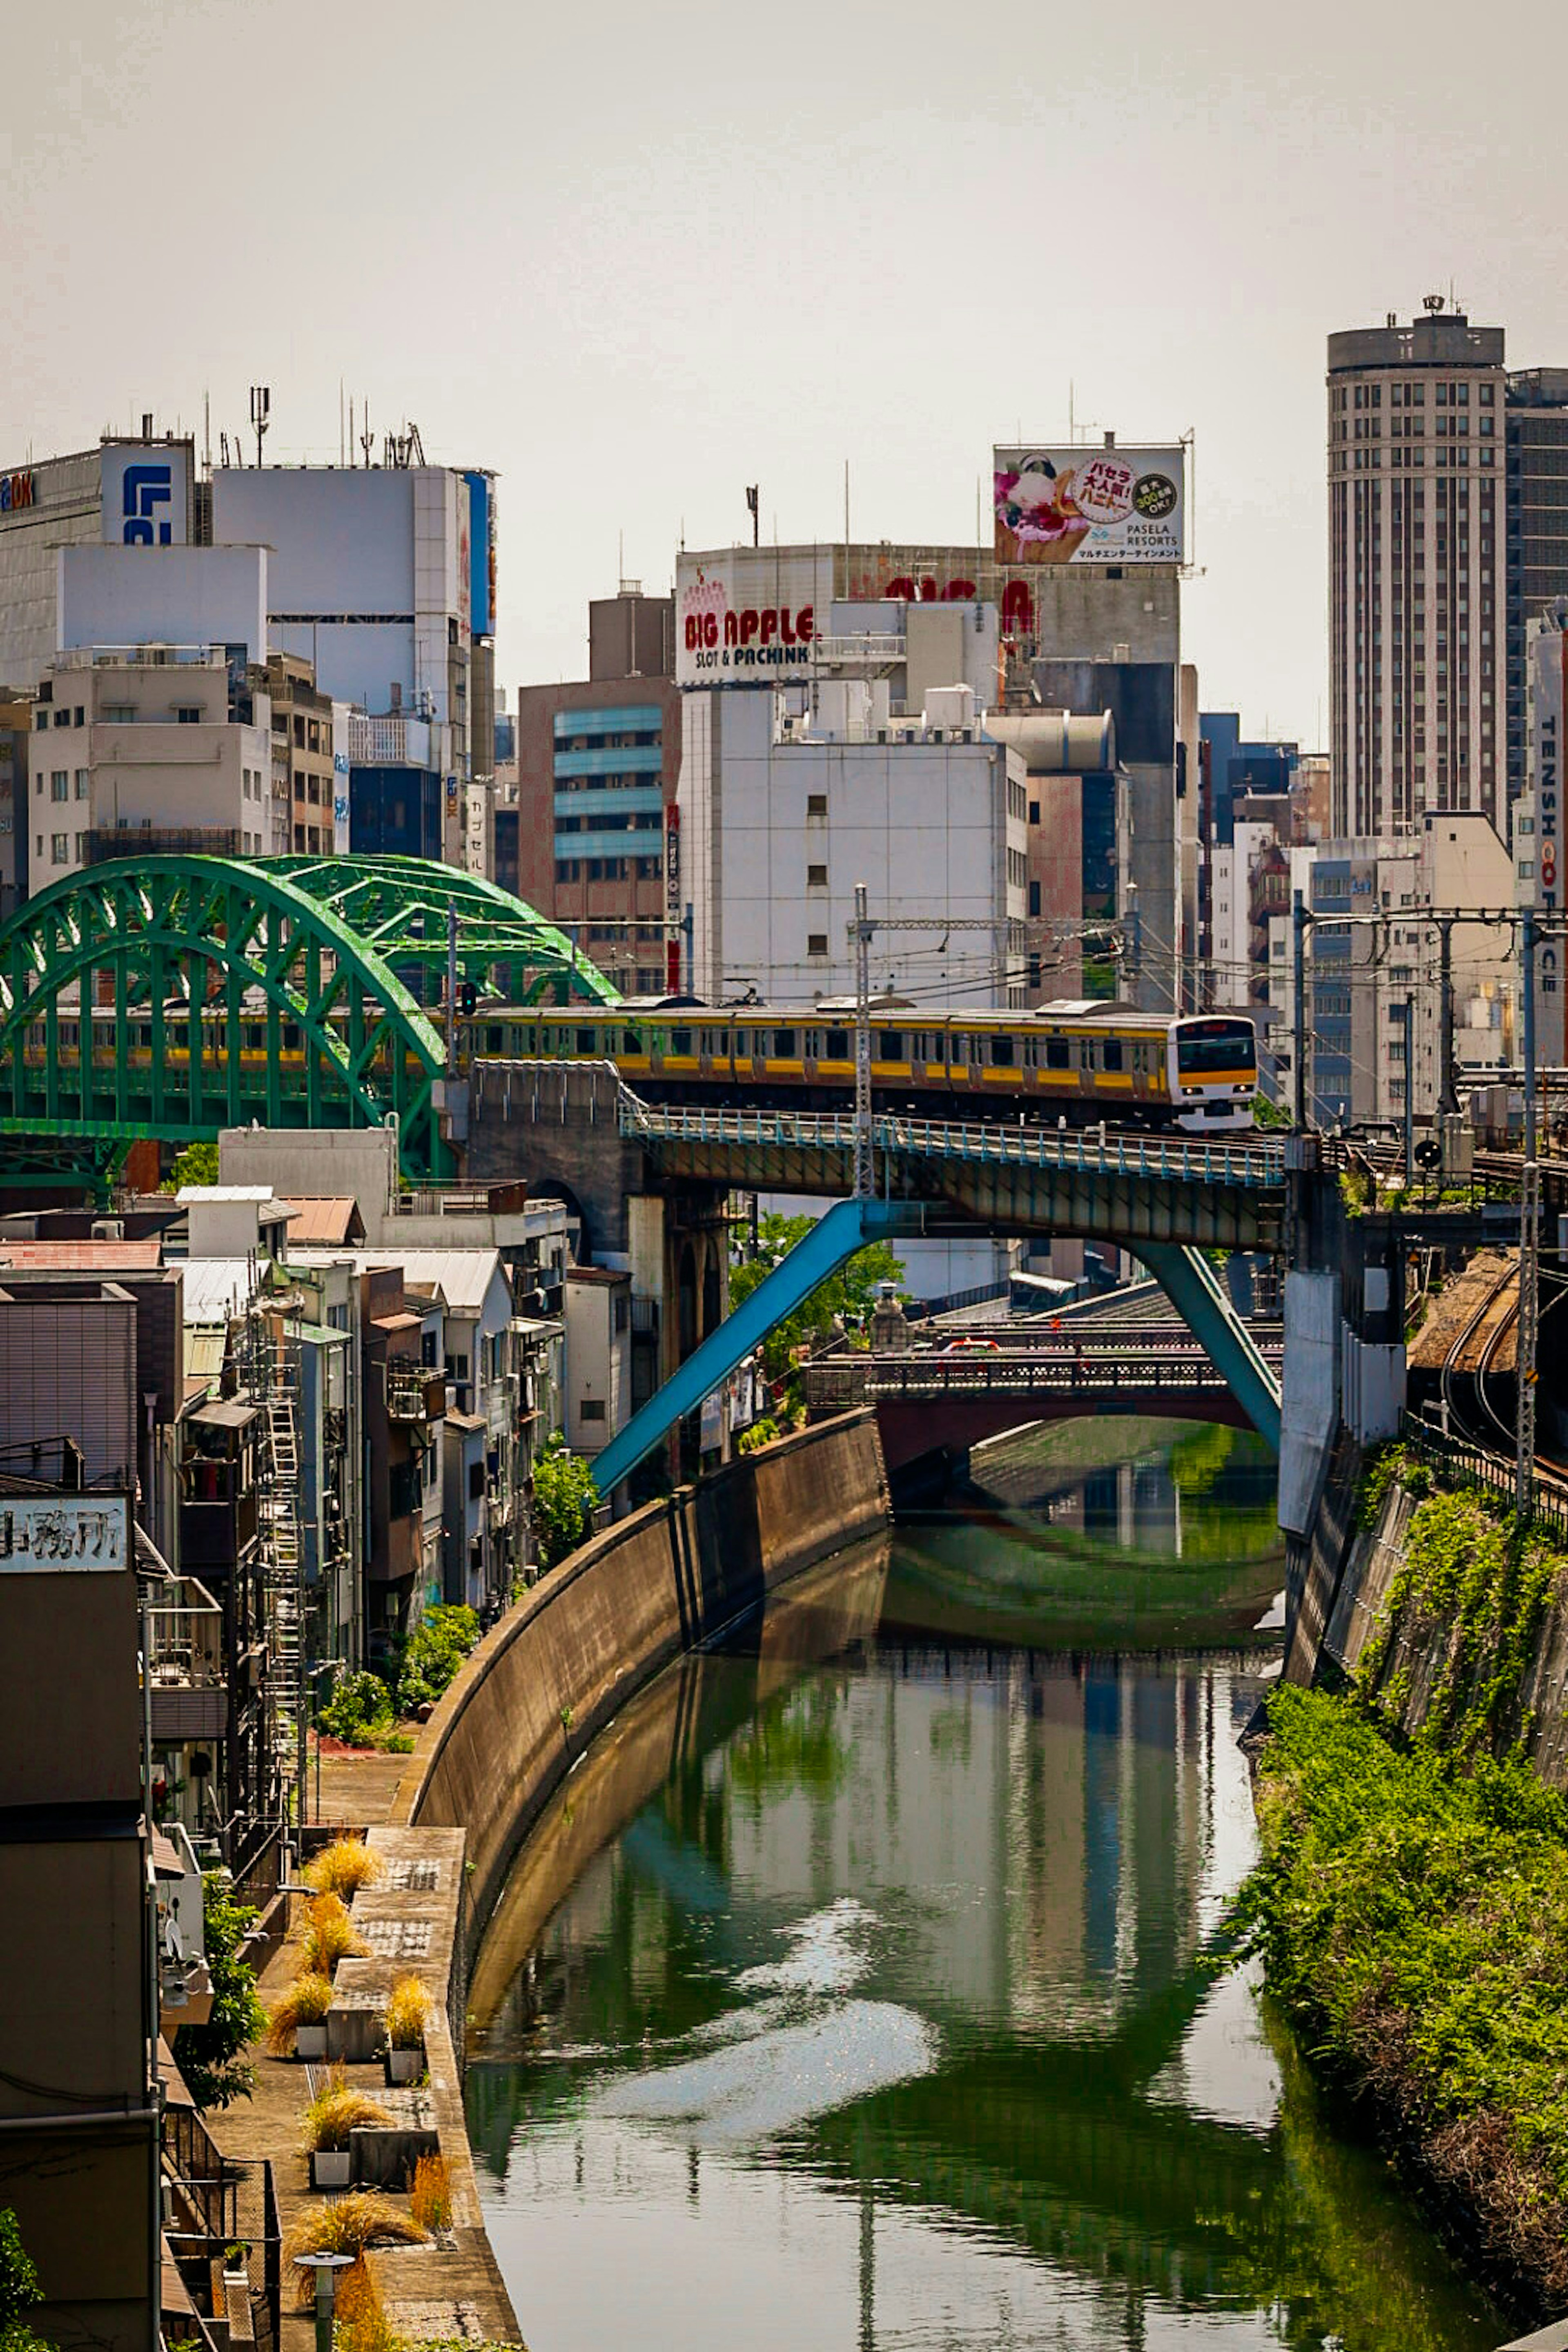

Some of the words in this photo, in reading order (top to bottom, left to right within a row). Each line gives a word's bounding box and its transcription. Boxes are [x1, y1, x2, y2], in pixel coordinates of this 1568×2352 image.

[1127, 525, 1169, 534] PASELA
[1127, 537, 1177, 546] RESORTS
[686, 612, 718, 650] BIG
[696, 652, 718, 668] SLOT
[723, 650, 729, 666] &
[1542, 716, 1556, 863] TENSHO
